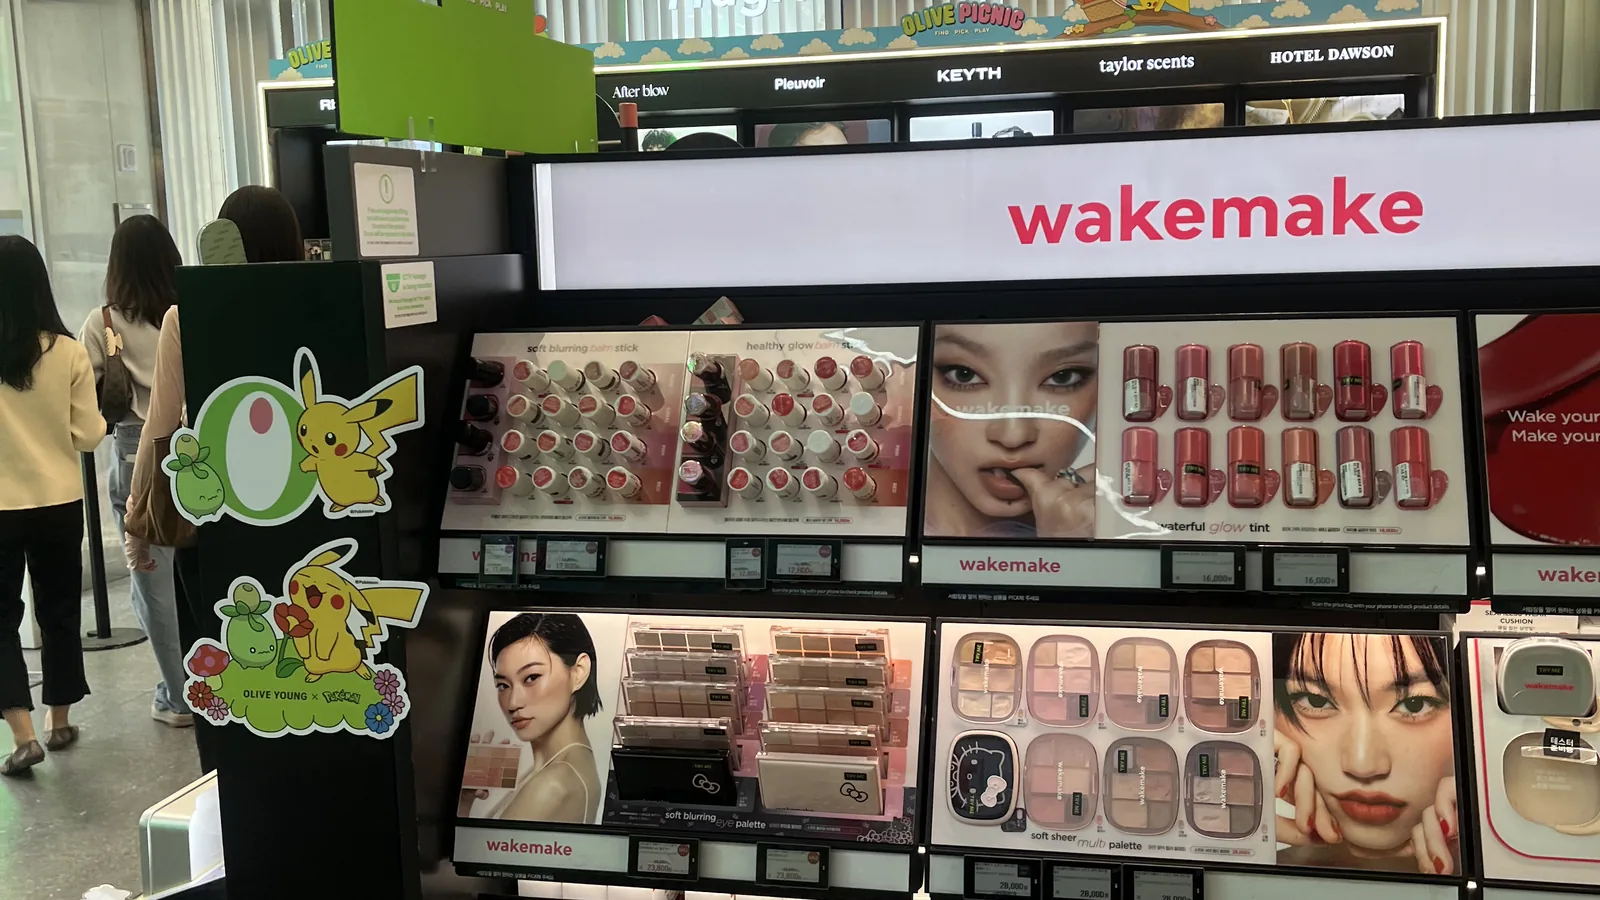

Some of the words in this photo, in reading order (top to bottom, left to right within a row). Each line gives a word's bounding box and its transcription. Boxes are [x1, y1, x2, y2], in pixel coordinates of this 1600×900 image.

[901, 3, 956, 37] OLIVE
[959, 1, 1025, 31] PICNIC
[288, 40, 332, 69] OLIVE
[1270, 48, 1324, 64] HOTEL
[1328, 45, 1394, 61] DAWSON
[1099, 57, 1143, 77] taylor
[1146, 54, 1195, 70] scents
[937, 66, 1002, 82] KEYTH
[612, 84, 638, 98] After
[642, 84, 670, 97] blow
[774, 76, 826, 91] Pleuvoir
[1008, 176, 1424, 245] wakemake
[527, 344, 546, 353] soft
[549, 344, 588, 354] blurring
[615, 344, 639, 352] stick
[746, 342, 785, 351] healthy
[788, 340, 813, 351] glow
[1507, 410, 1556, 423] Wake
[1560, 412, 1600, 425] your
[1512, 430, 1557, 442] Make
[1209, 521, 1246, 534] glow
[1249, 522, 1270, 532] tint
[959, 557, 1061, 573] wakemake
[1537, 566, 1600, 583] wake
[243, 690, 271, 699] OLIVE
[274, 691, 308, 700] YOUNG
[1524, 682, 1574, 692] wakemake
[1550, 737, 1574, 747] 테스터
[665, 810, 682, 820] soft
[683, 812, 716, 824] blurring
[716, 818, 734, 828] eye
[736, 820, 766, 830] palette
[486, 838, 573, 856] wakemake
[1031, 832, 1048, 840] soft
[1052, 832, 1077, 842] sheer
[1077, 839, 1106, 848] multi
[1109, 841, 1142, 850] palette
